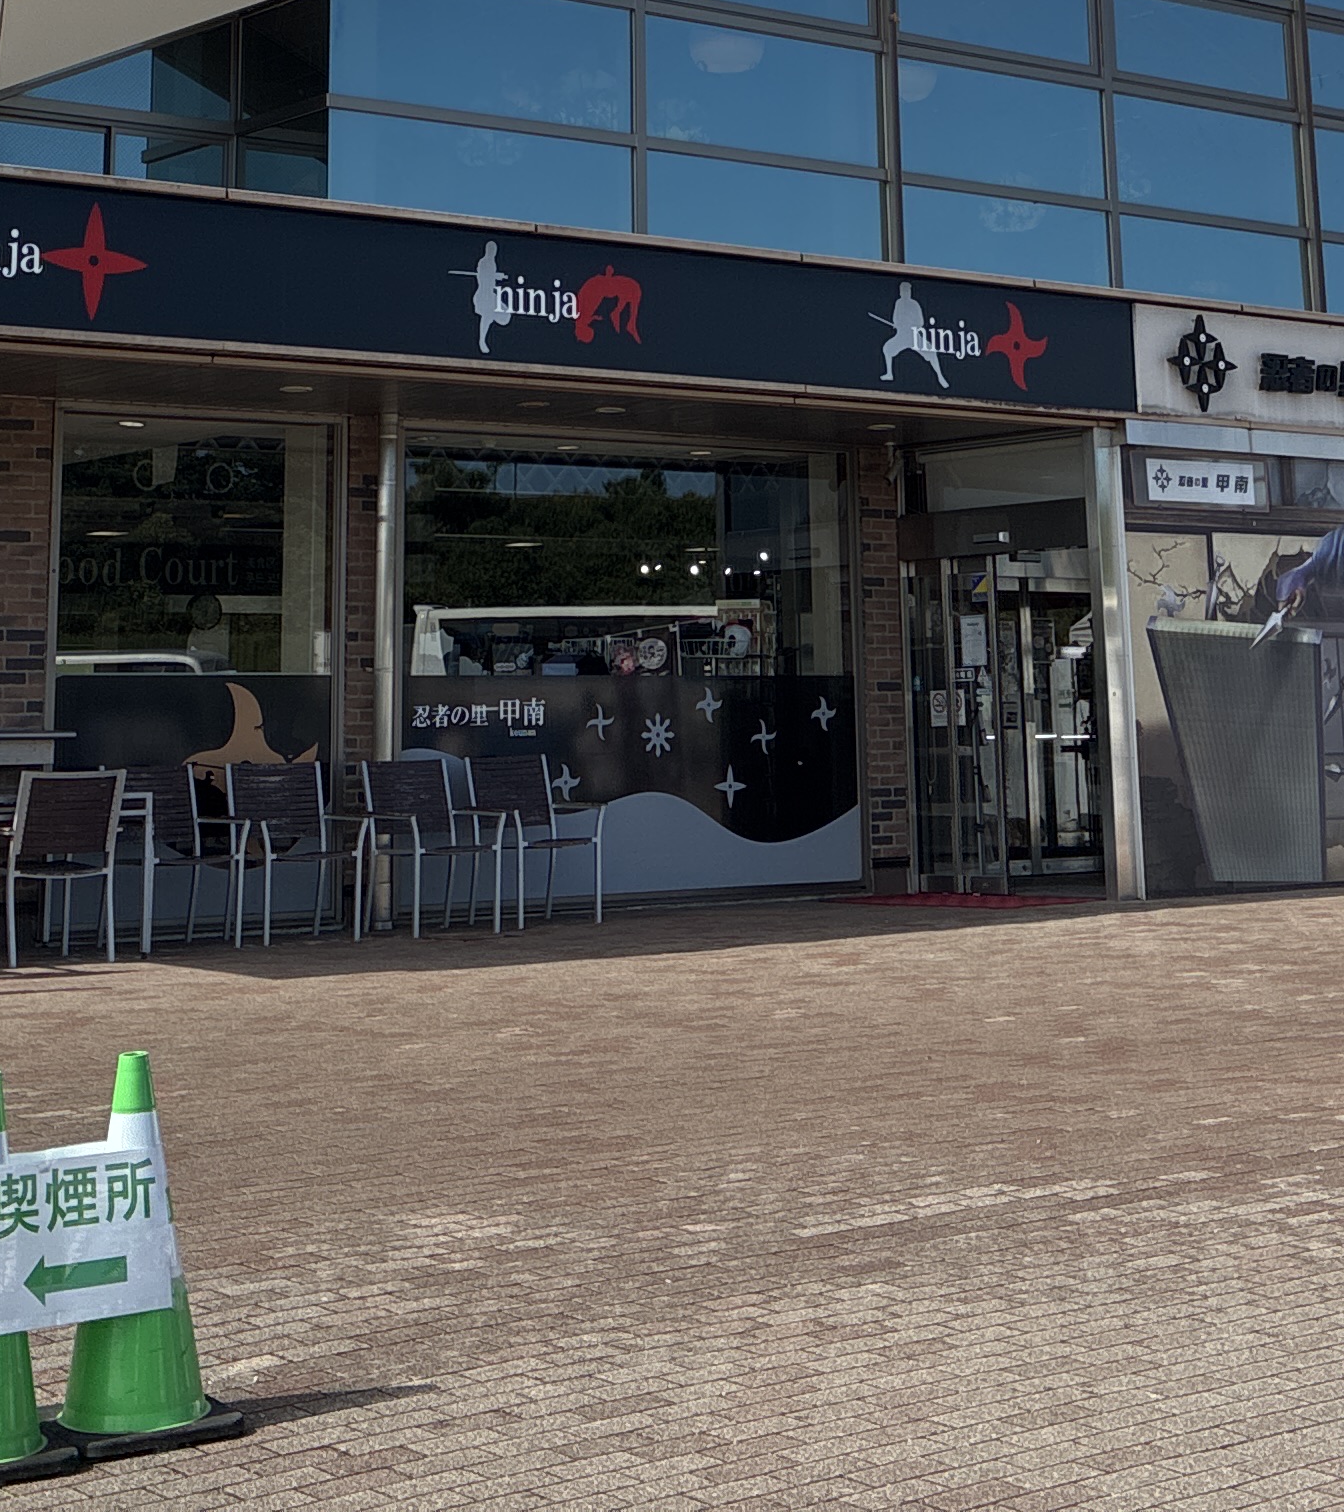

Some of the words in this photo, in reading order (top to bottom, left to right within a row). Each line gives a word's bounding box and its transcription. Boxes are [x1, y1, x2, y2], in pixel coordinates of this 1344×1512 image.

[493, 275, 581, 324] ninja
[911, 316, 982, 360] ninja
[1215, 473, 1249, 494] 甲南
[57, 547, 127, 587] ood
[139, 546, 239, 587] Court
[411, 703, 489, 728] 忍者の里
[499, 697, 546, 727] 甲南
